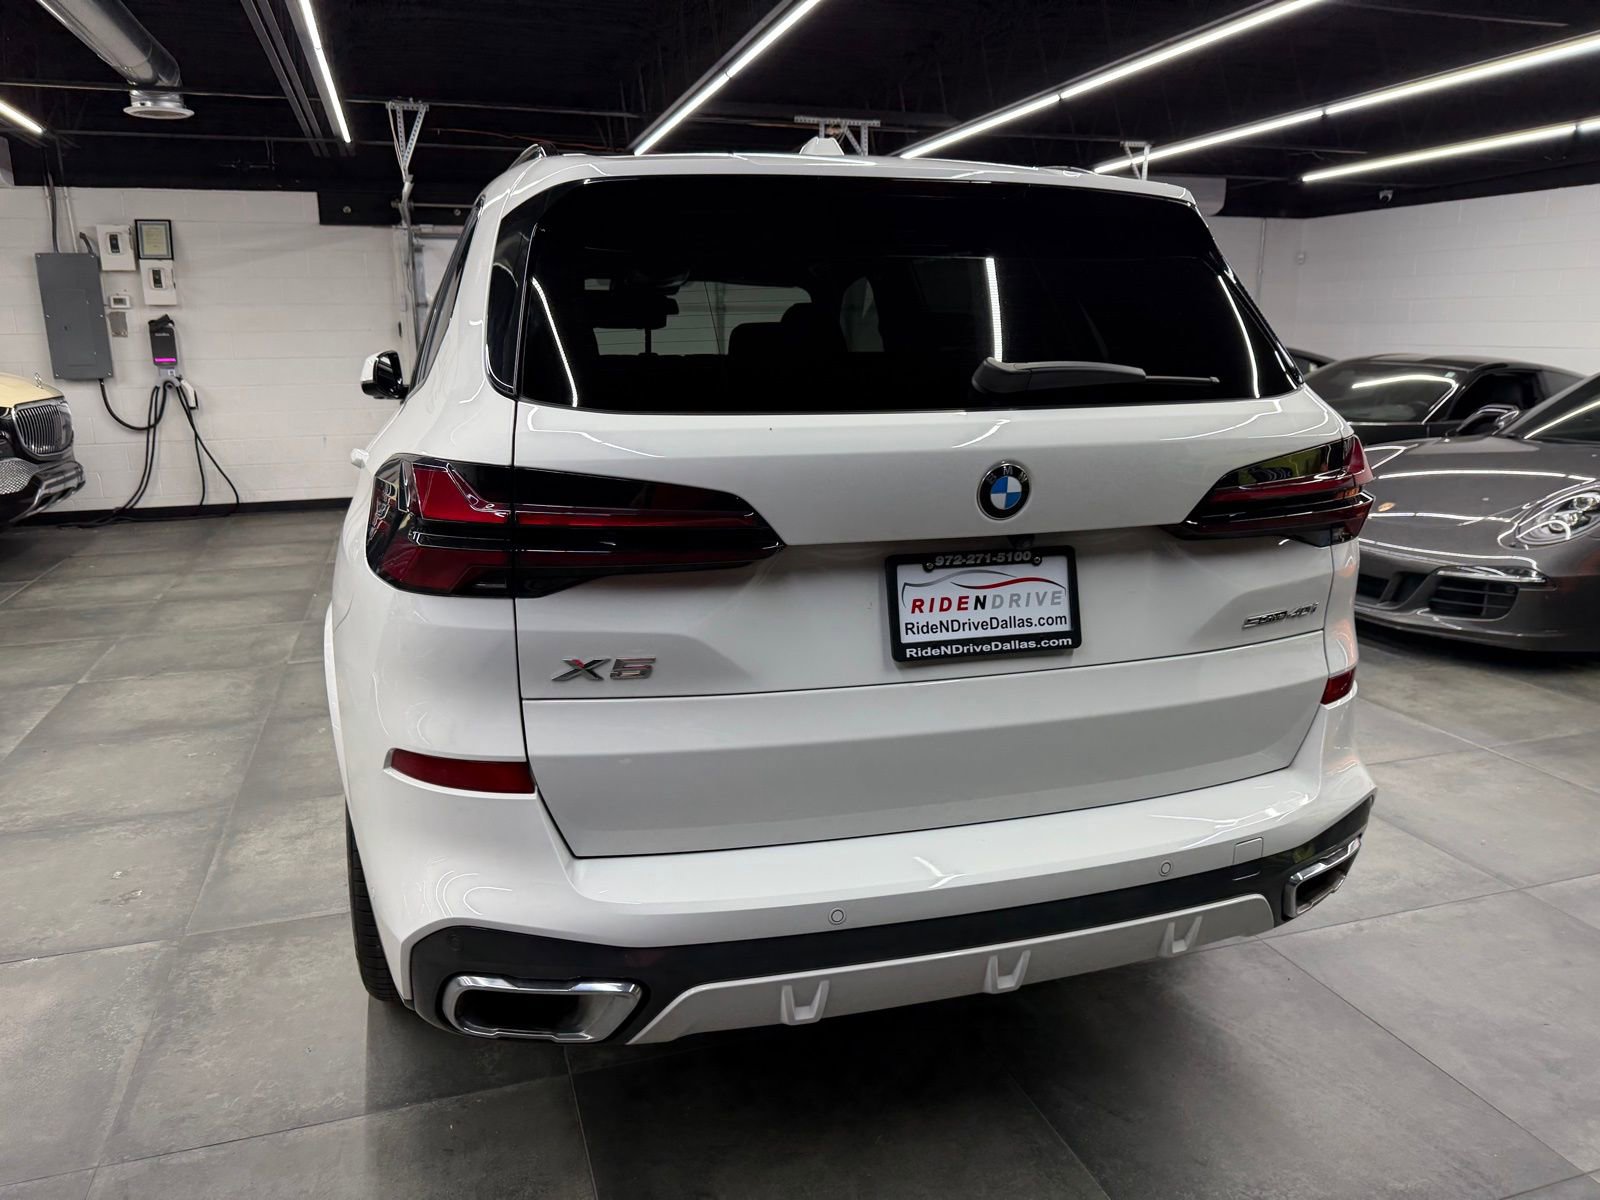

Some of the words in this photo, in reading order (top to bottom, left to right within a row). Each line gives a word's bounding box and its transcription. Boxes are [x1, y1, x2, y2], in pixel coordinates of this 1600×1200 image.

[935, 551, 1031, 566] 972-271-5100
[911, 590, 1064, 614] RIDENDRIVE
[905, 615, 1067, 635] RideNDriveDallas.com
[906, 637, 1072, 658] RideNDriveDallas.com
[551, 658, 656, 681] X5
